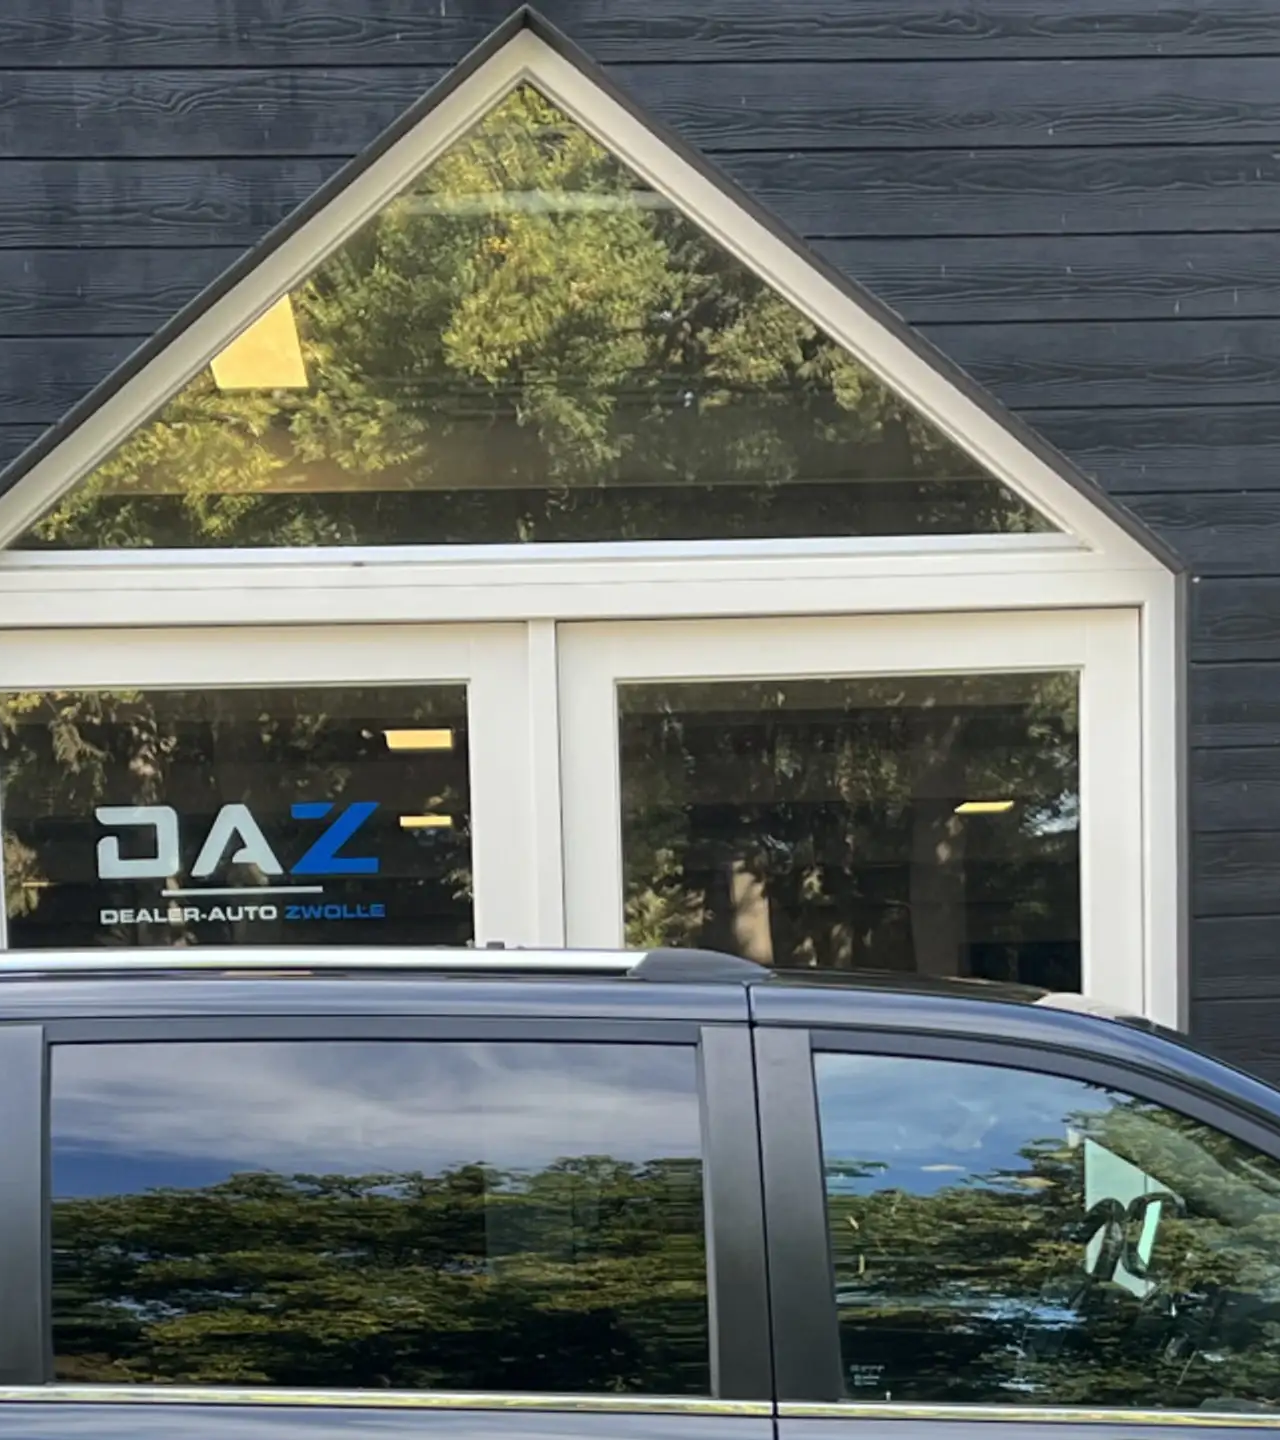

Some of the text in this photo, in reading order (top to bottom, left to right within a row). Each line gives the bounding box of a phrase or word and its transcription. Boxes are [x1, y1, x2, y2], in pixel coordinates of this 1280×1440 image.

[95, 802, 380, 880] DAZ
[100, 902, 386, 925] DEALER-AUTO ZWOLLE
